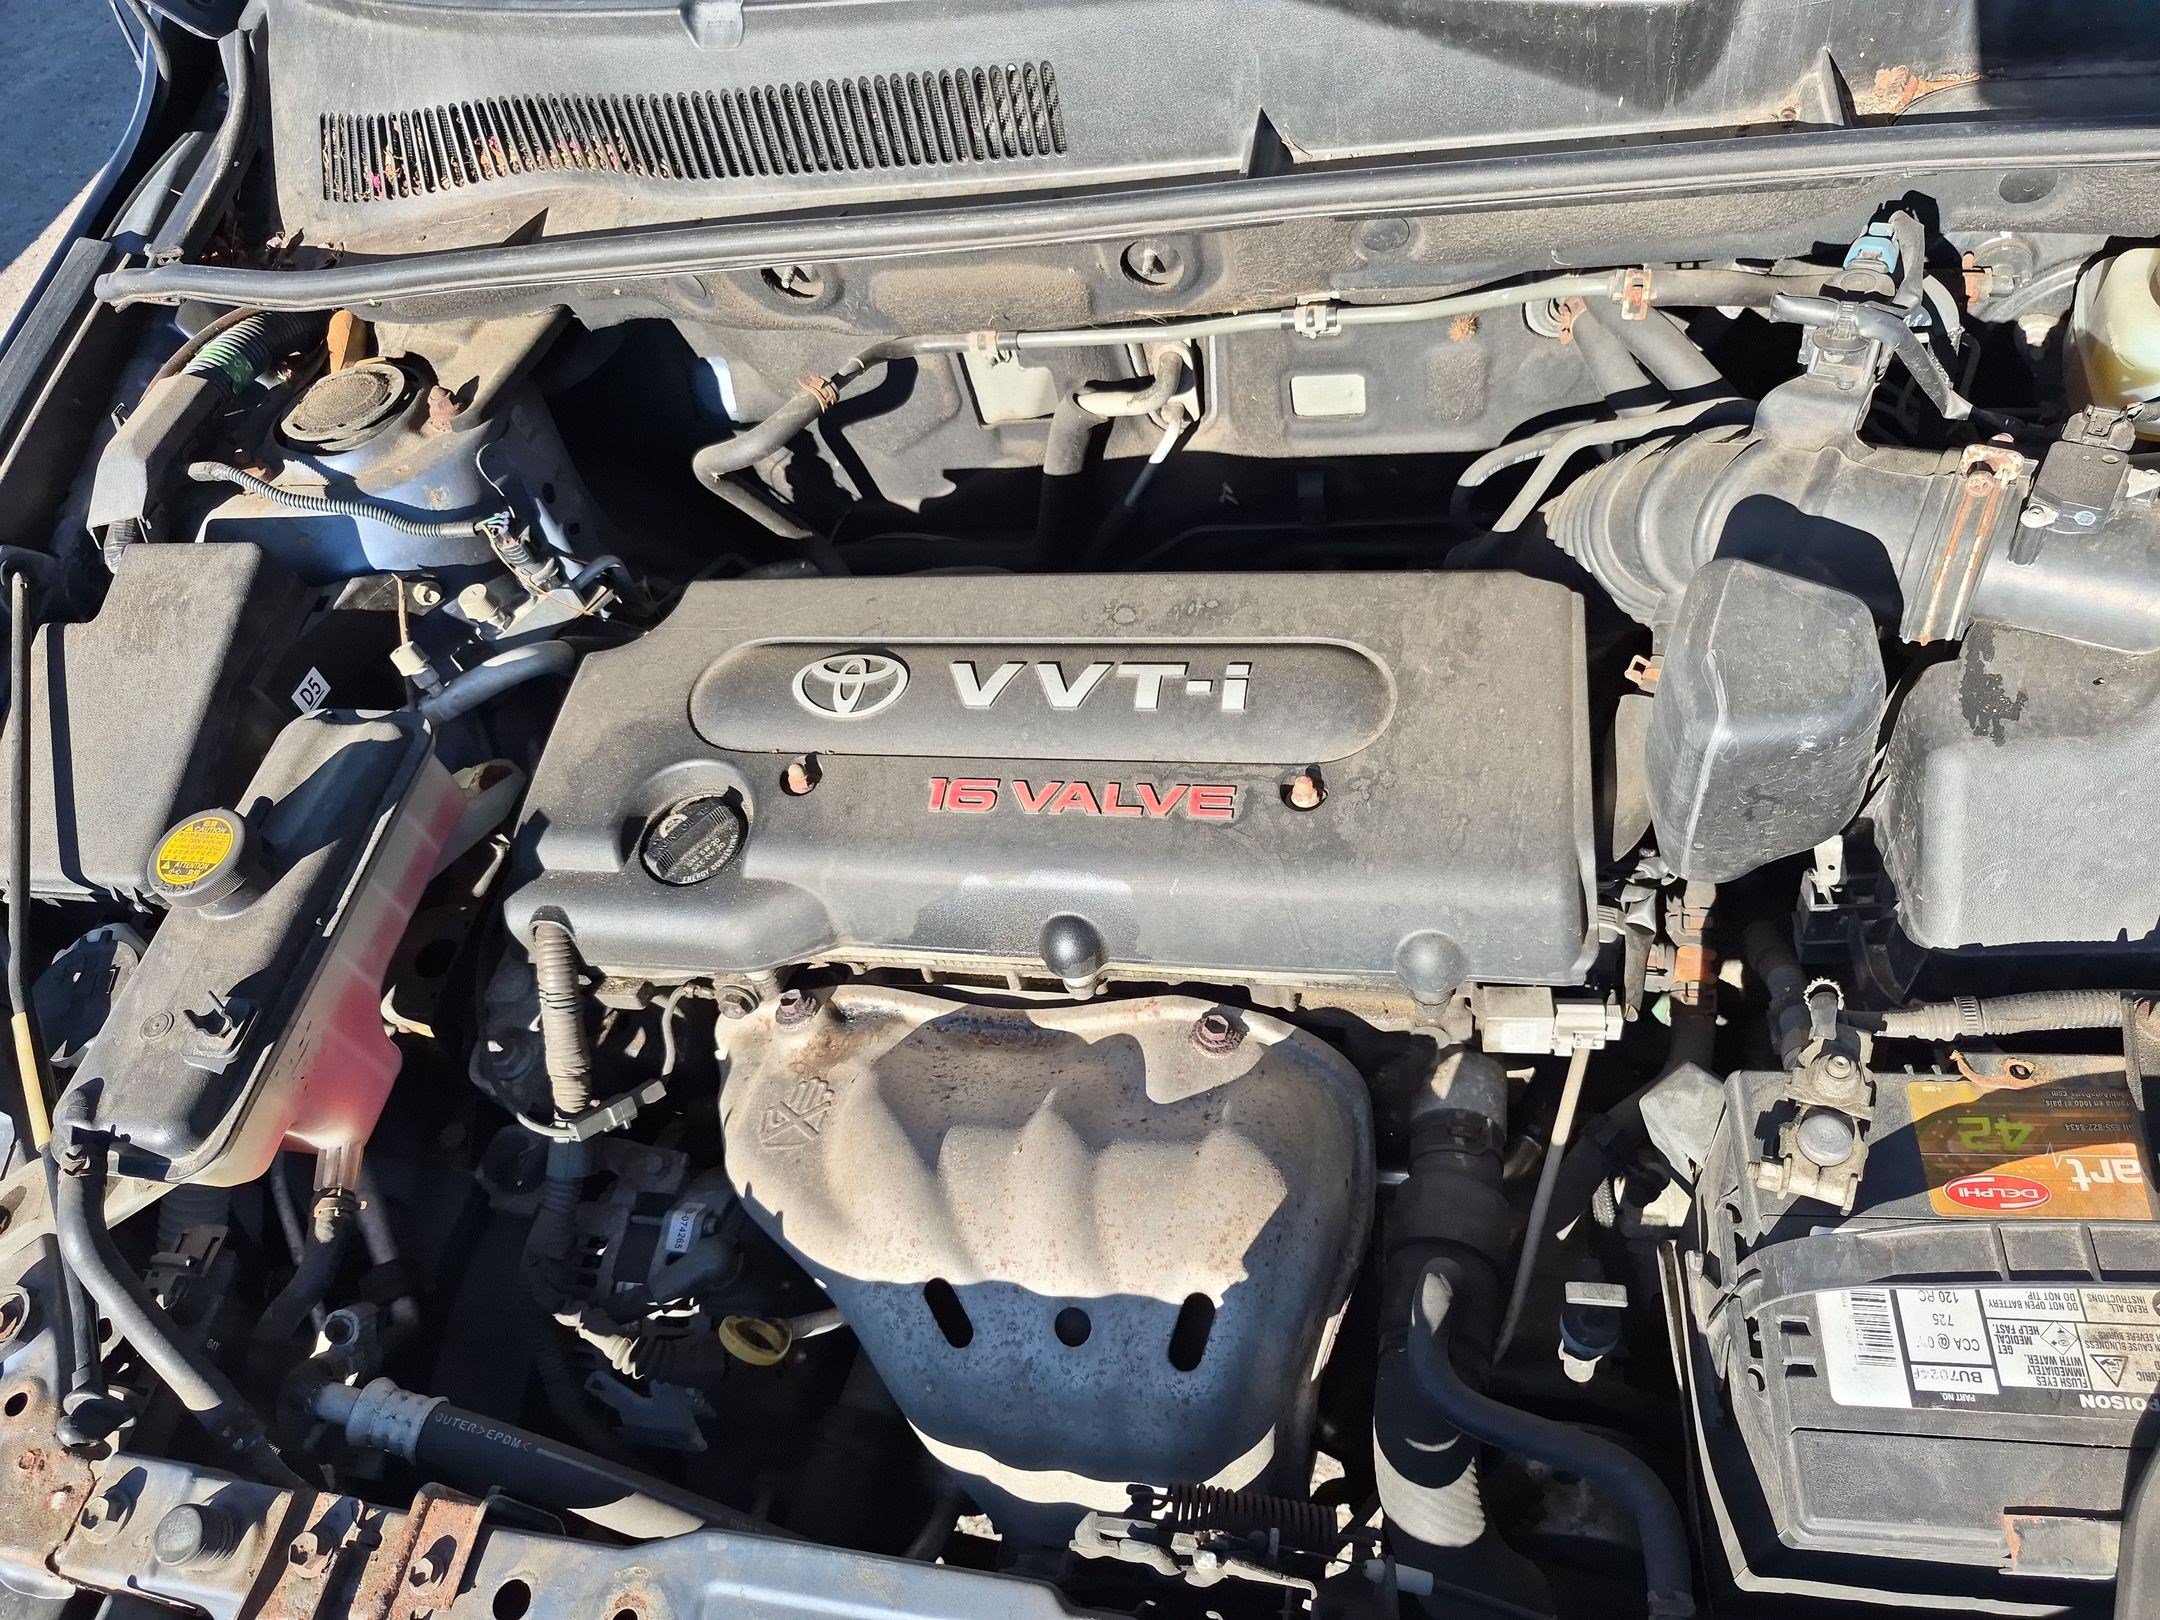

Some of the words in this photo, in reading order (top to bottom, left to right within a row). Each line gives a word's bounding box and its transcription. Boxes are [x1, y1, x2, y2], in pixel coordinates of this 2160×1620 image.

[949, 660, 1252, 711] VVT-i
[300, 677, 321, 707] D5
[928, 777, 1001, 812] 16
[1010, 778, 1237, 820] VALVE
[1956, 1116, 2034, 1152] 42
[2066, 1159, 2143, 1192] art
[1958, 1187, 2038, 1199] DELPHI
[1938, 1290, 1958, 1303] 120
[2043, 1292, 2061, 1302] NOT
[2063, 1292, 2076, 1302] DO
[2083, 1293, 2146, 1305] INSTRUCTIONS.
[1985, 1298, 2022, 1309] BATTERY.
[2024, 1300, 2046, 1310] OPEN
[2048, 1301, 2064, 1311] NOT
[2066, 1302, 2079, 1311] DO
[2109, 1303, 2124, 1313] ALL
[2125, 1304, 2148, 1314] READ
[1932, 1313, 1954, 1327] 725
[1992, 1324, 2016, 1334] FAST.
[2018, 1325, 2040, 1336] HELP
[1994, 1334, 2033, 1346] MEDICAL
[2125, 1331, 2154, 1342] SEVERE
[1954, 1337, 1980, 1352] CCA
[1997, 1344, 2014, 1355] GET
[2084, 1339, 2127, 1352] BLINDNESS
[2128, 1341, 2153, 1353] CAUSE
[2024, 1354, 2056, 1366] WATER.
[2059, 1355, 2083, 1367] WITH
[2027, 1365, 2085, 1378] IMMEDIATELY
[2136, 1371, 2160, 1382] URIC
[2035, 1376, 2058, 1388] EYES
[2059, 1377, 2088, 1389] FLUSH
[1940, 1392, 1955, 1401] NO.
[1955, 1393, 1976, 1402] PART
[2078, 1393, 2160, 1412] POISON
